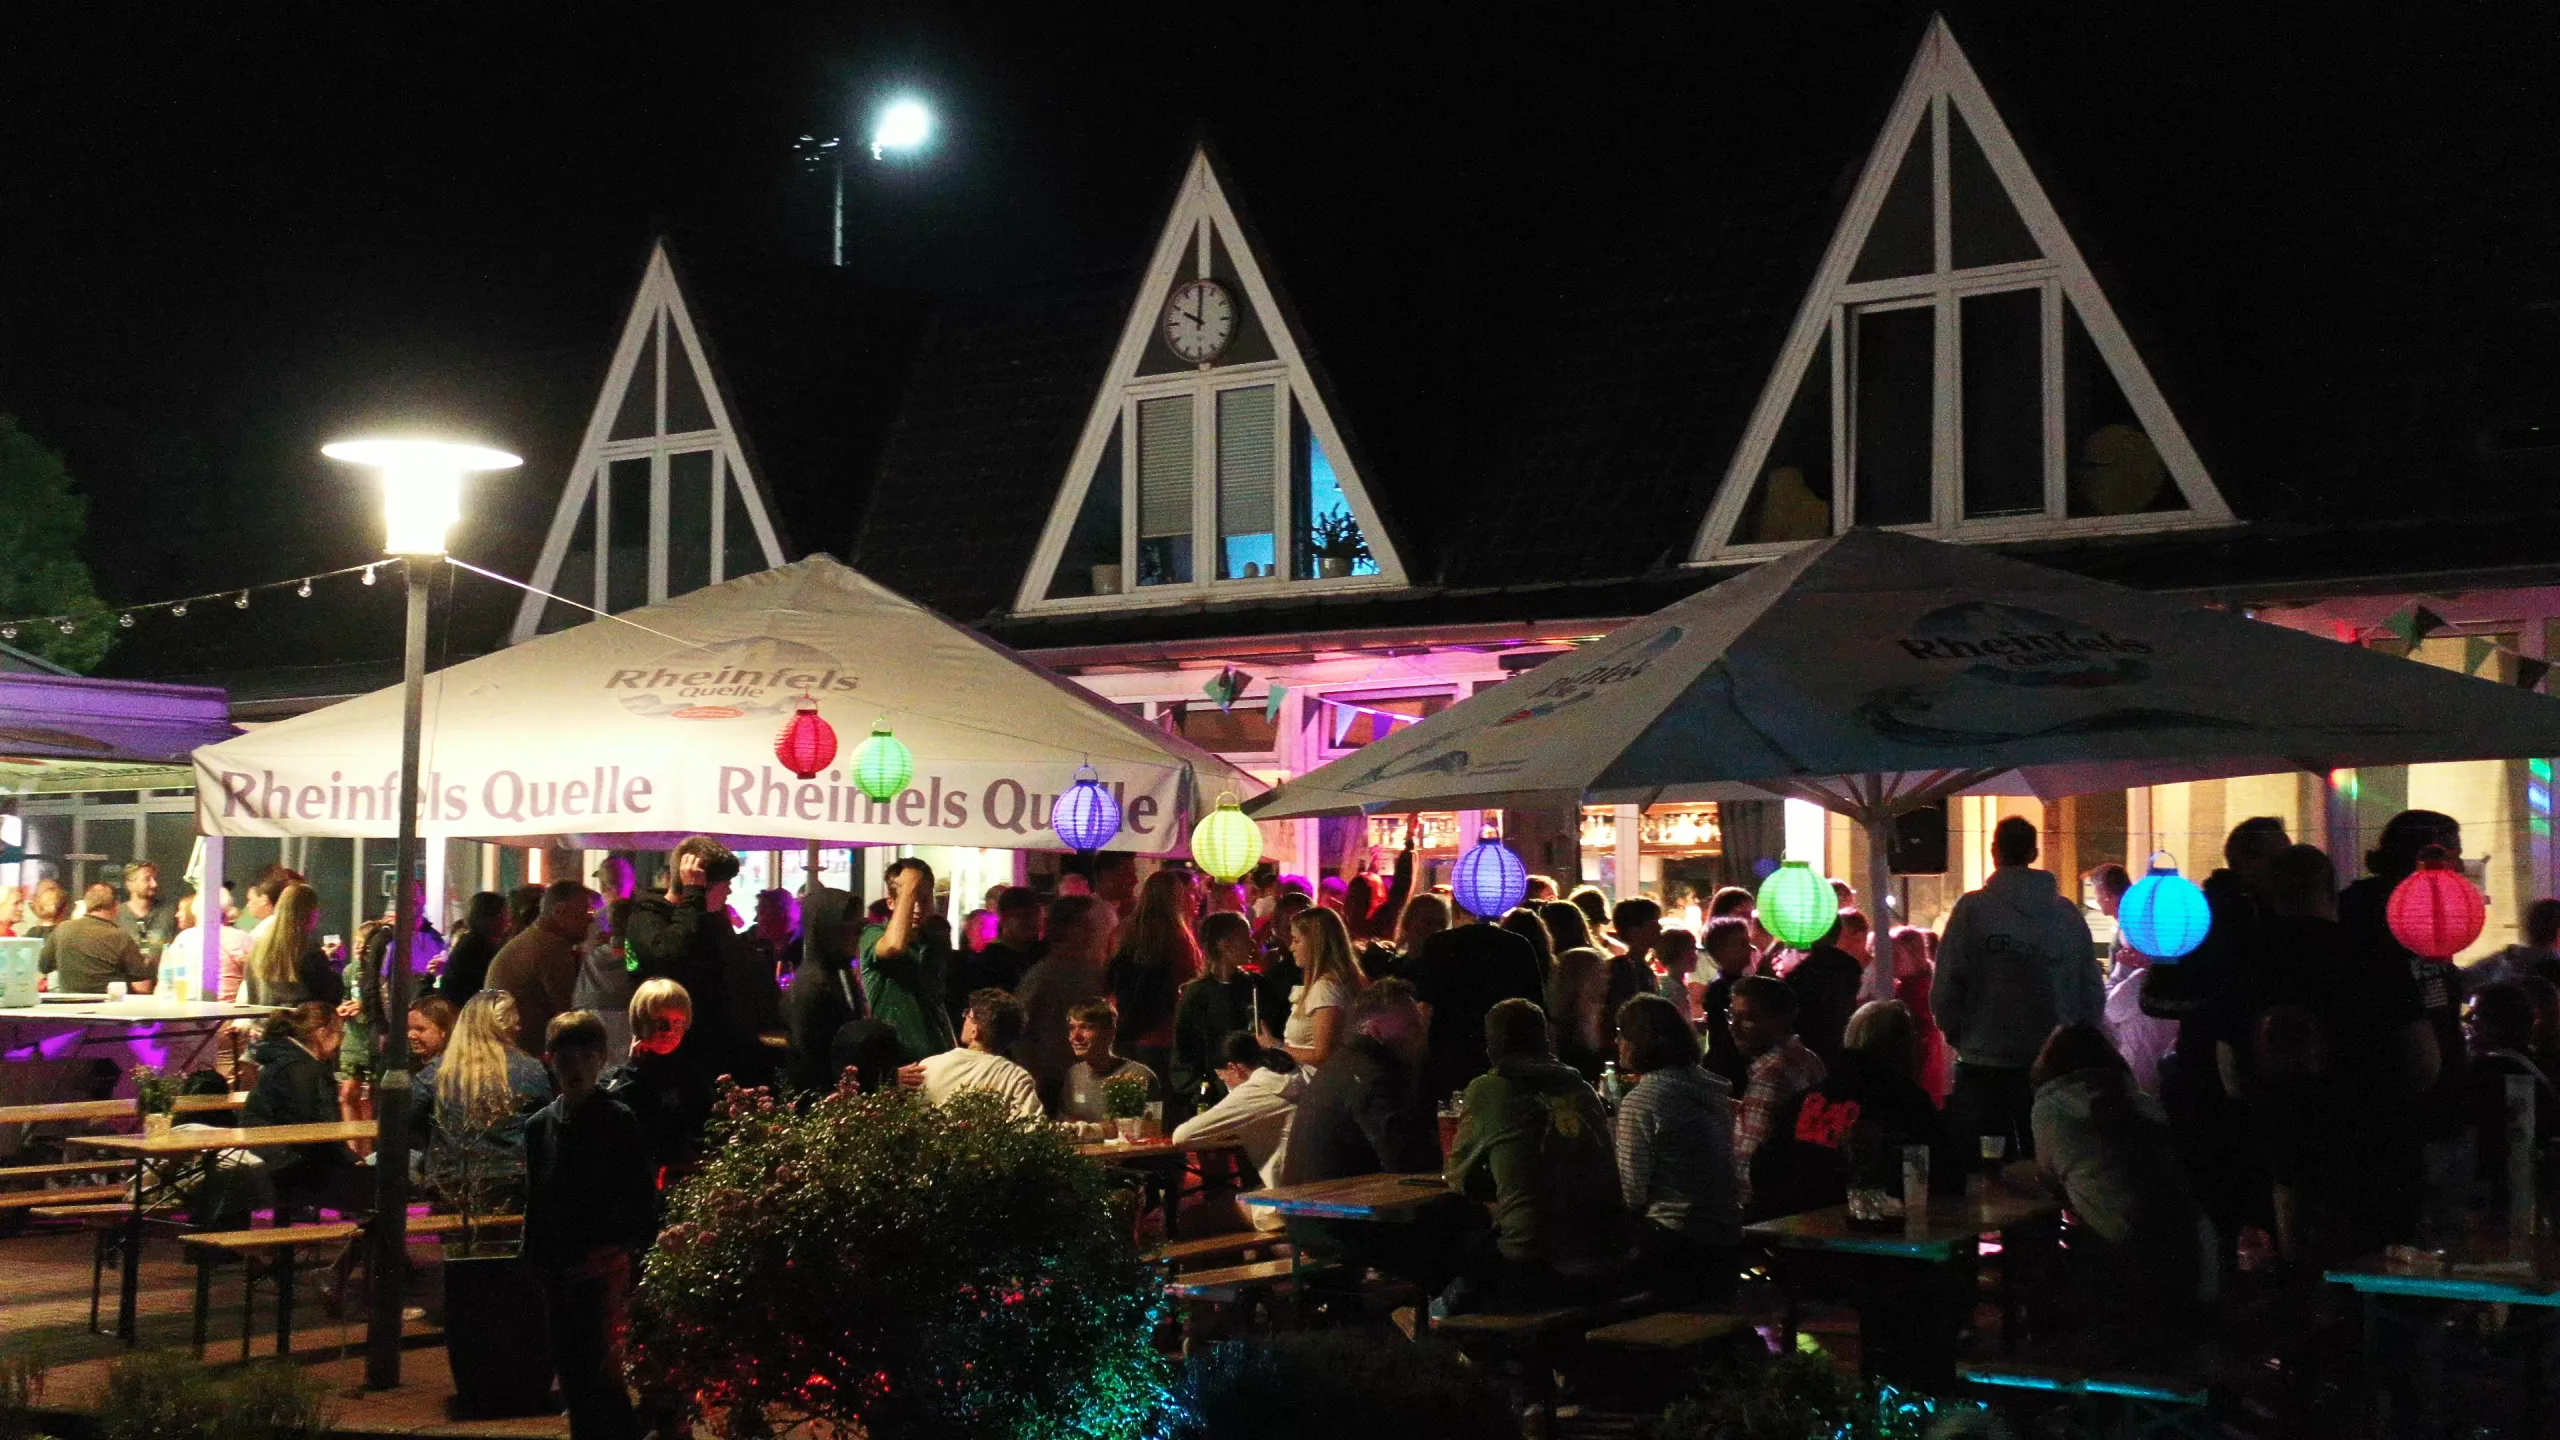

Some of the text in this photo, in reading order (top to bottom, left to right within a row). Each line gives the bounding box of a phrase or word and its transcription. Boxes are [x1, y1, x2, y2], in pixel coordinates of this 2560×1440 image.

[604, 665, 860, 692] Rheinfels
[678, 684, 765, 698] Quelle
[482, 765, 652, 823] Quelle
[982, 778, 1158, 834] Qule
